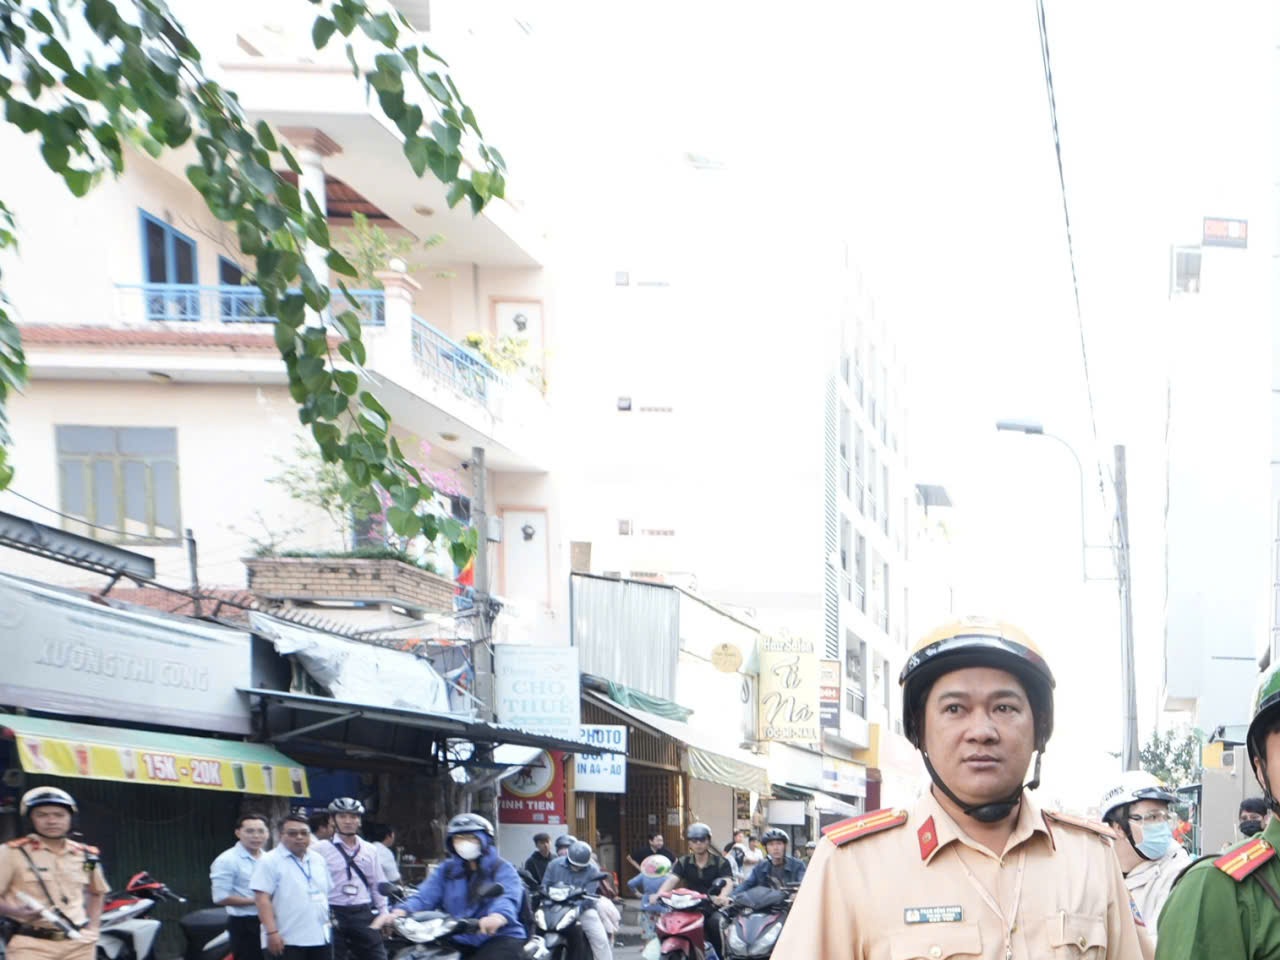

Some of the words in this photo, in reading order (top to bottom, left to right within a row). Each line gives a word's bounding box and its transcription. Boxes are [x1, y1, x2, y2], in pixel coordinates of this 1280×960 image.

[143, 753, 180, 781] 15K
[191, 758, 223, 786] 20K
[577, 764, 587, 775] IN
